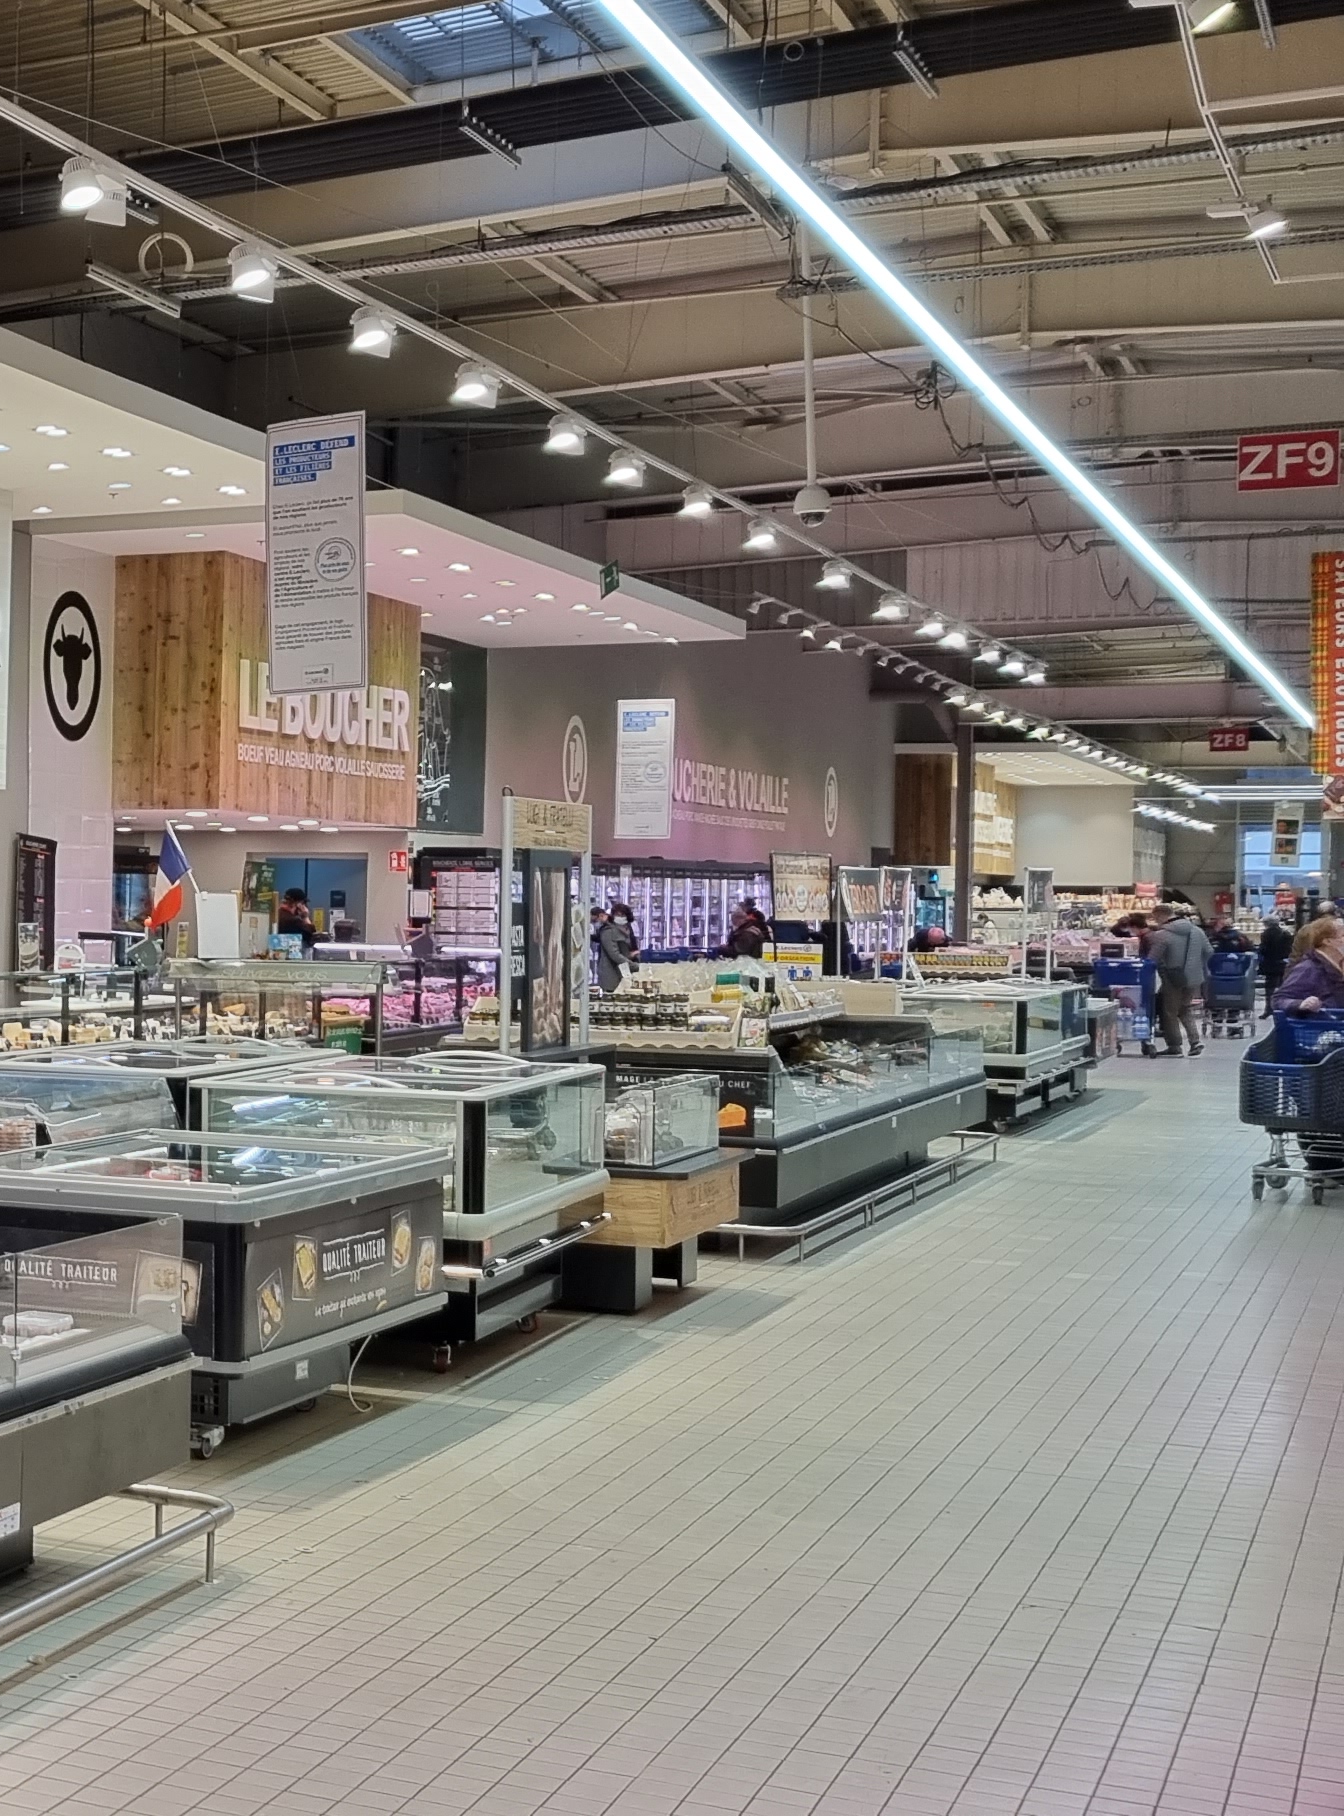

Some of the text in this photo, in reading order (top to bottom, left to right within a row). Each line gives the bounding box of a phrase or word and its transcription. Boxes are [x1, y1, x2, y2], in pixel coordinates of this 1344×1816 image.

[1240, 440, 1335, 482] ZF9
[239, 659, 410, 752] LE BOUCHER
[1212, 733, 1246, 748] ZF8
[238, 743, 264, 764] BOEUF
[265, 746, 284, 767] VEAU
[285, 749, 315, 770] AGNEAU
[316, 753, 335, 773] PORC
[335, 756, 366, 776] VOLAILLE
[738, 770, 789, 814] VOLAILLE
[323, 1238, 385, 1272] QUALITÉ TRAITEUR
[61, 1263, 117, 1282] TRAITEUR
